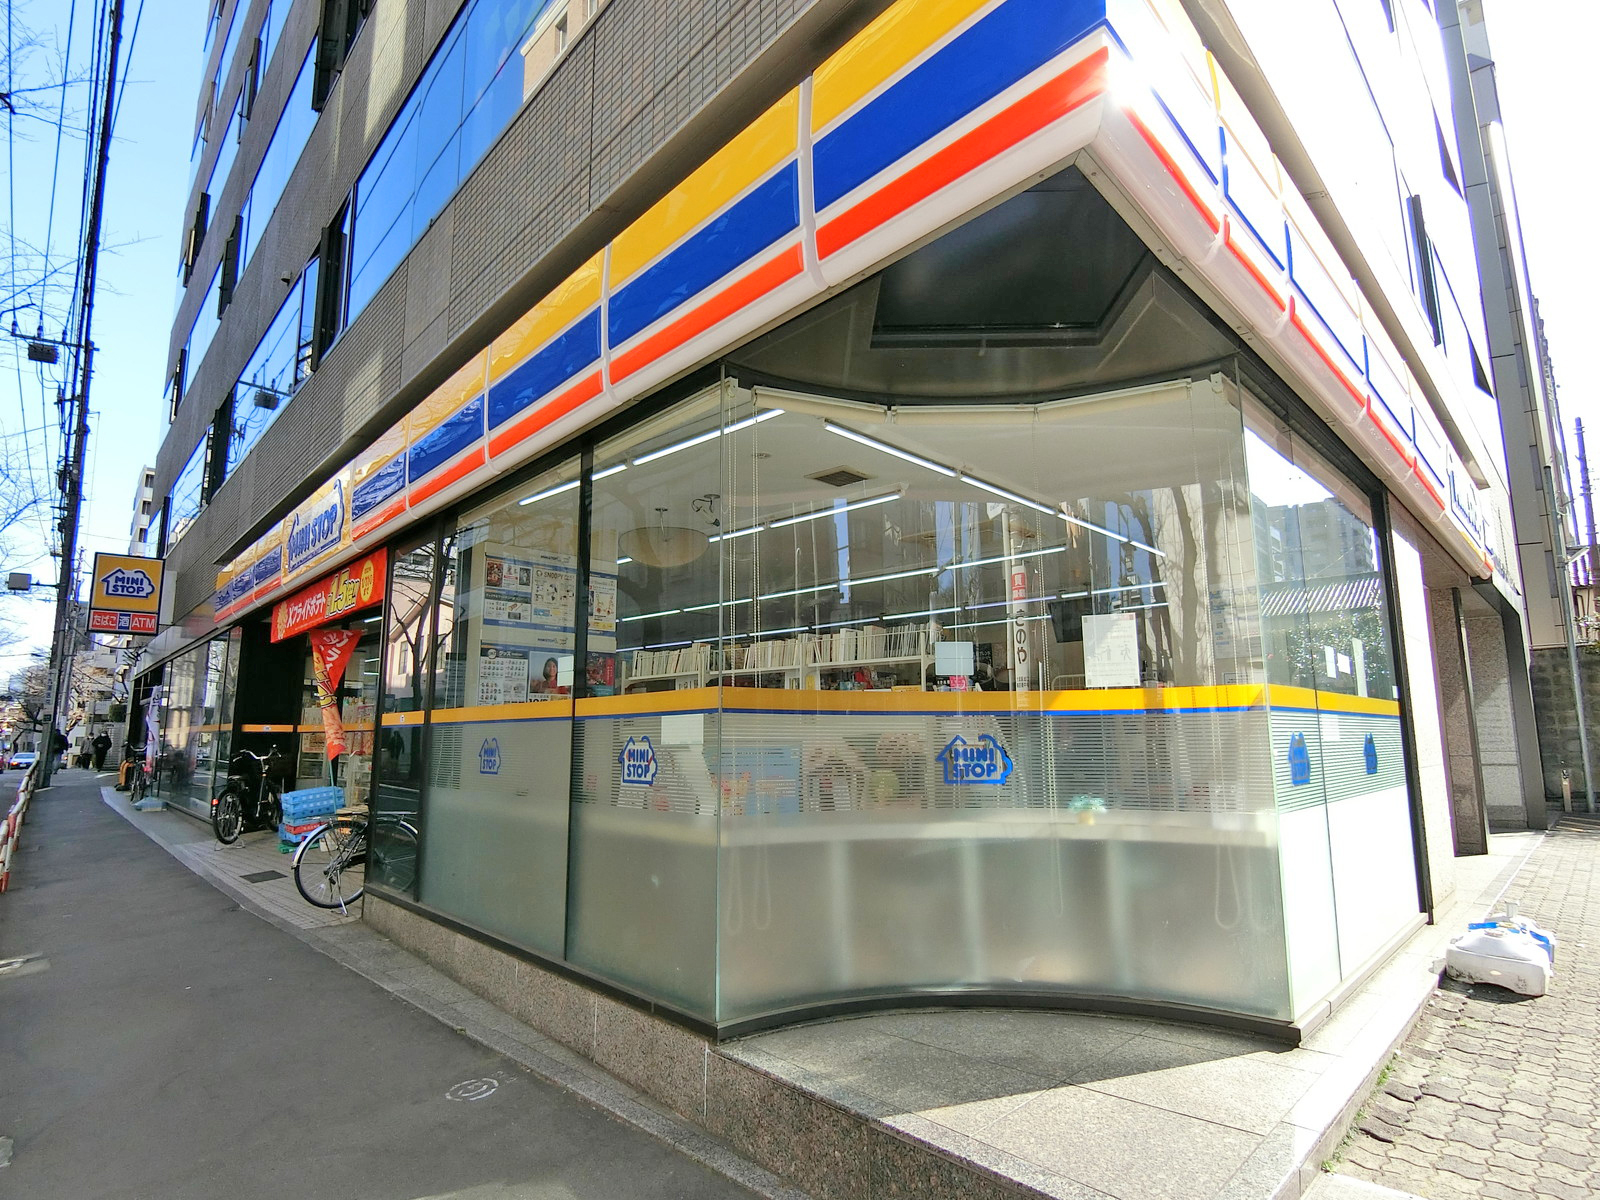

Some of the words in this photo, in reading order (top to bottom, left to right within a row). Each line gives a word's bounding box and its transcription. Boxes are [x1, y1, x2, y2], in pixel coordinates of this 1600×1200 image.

[311, 503, 337, 547] STOP
[114, 575, 144, 586] MINI
[112, 584, 145, 594] STOP
[93, 614, 117, 627] たばこ
[119, 616, 131, 627] 酒
[132, 617, 156, 629] ATM
[483, 747, 497, 758] MINI
[628, 748, 649, 763] MINI
[953, 748, 995, 763] MINI
[482, 758, 497, 770] STOP
[627, 763, 651, 779] STOP
[952, 762, 998, 778] STOP
